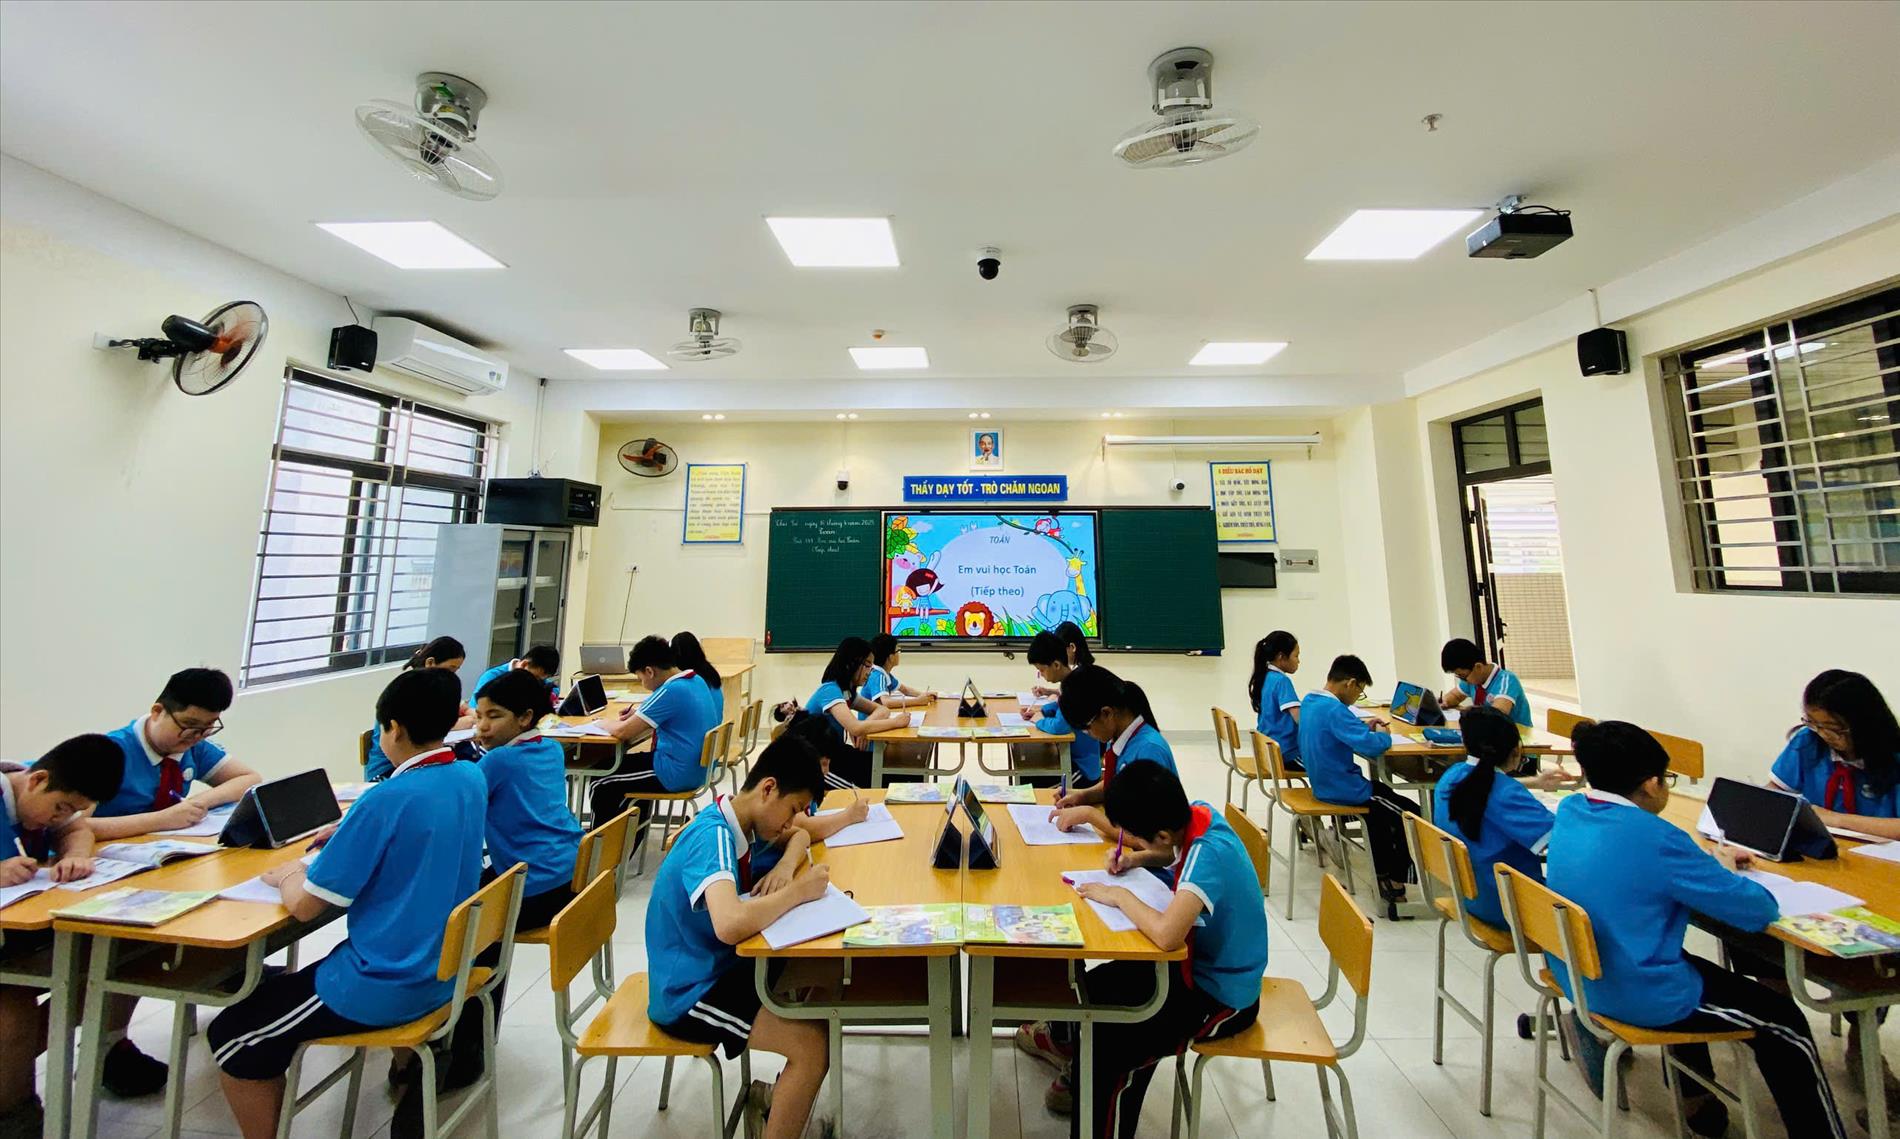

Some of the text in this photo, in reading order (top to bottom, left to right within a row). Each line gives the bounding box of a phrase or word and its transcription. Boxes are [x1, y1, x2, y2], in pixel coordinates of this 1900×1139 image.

[936, 483, 954, 498] DẠY
[956, 478, 974, 494] TỐT
[980, 480, 998, 494] TRÒ
[1000, 480, 1026, 494] CHĂM
[1028, 483, 1060, 494] NGOAN
[990, 534, 1010, 544] TOÁN
[958, 565, 1036, 575] Em vui học Toán
[971, 586, 1024, 597] (Tiếp theo)
